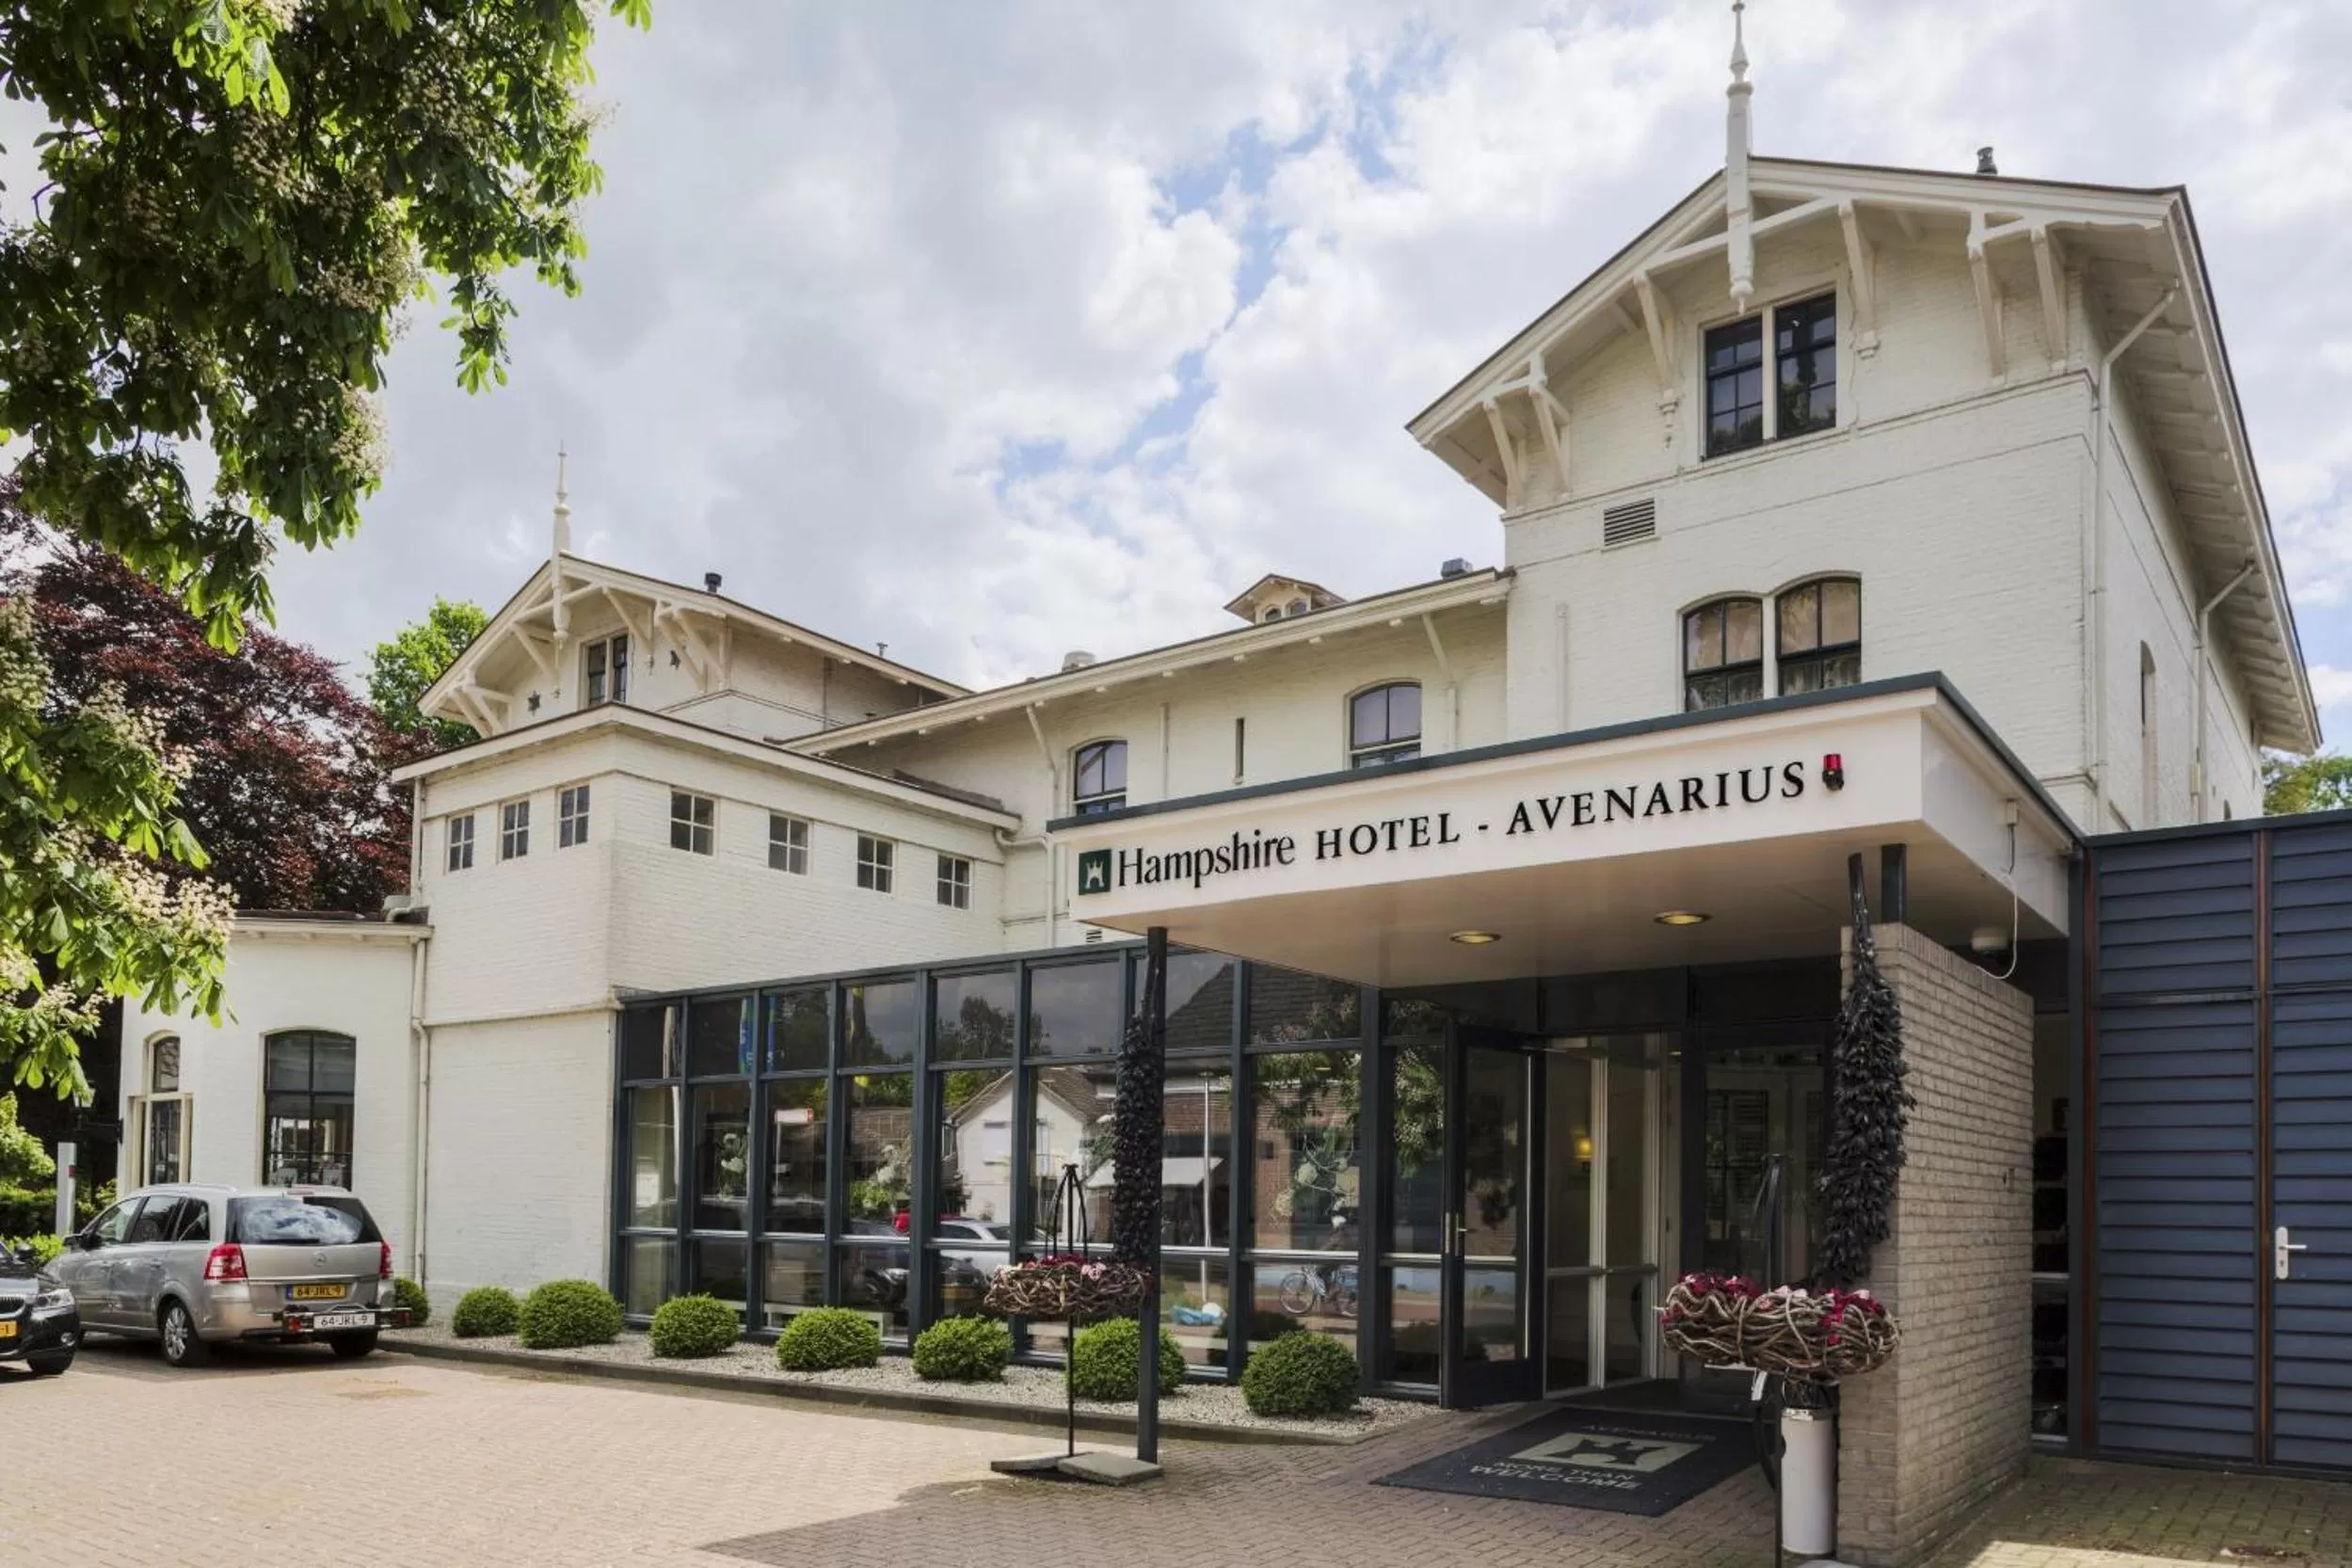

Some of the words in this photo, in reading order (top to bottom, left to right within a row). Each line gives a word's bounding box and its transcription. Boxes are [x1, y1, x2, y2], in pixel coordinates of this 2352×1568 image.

[1118, 829, 1296, 888] Hampshire
[1315, 812, 1460, 860] HOTEL
[1506, 760, 1805, 835] AVENARIUS
[1469, 1464, 1644, 1490] WELCOME
